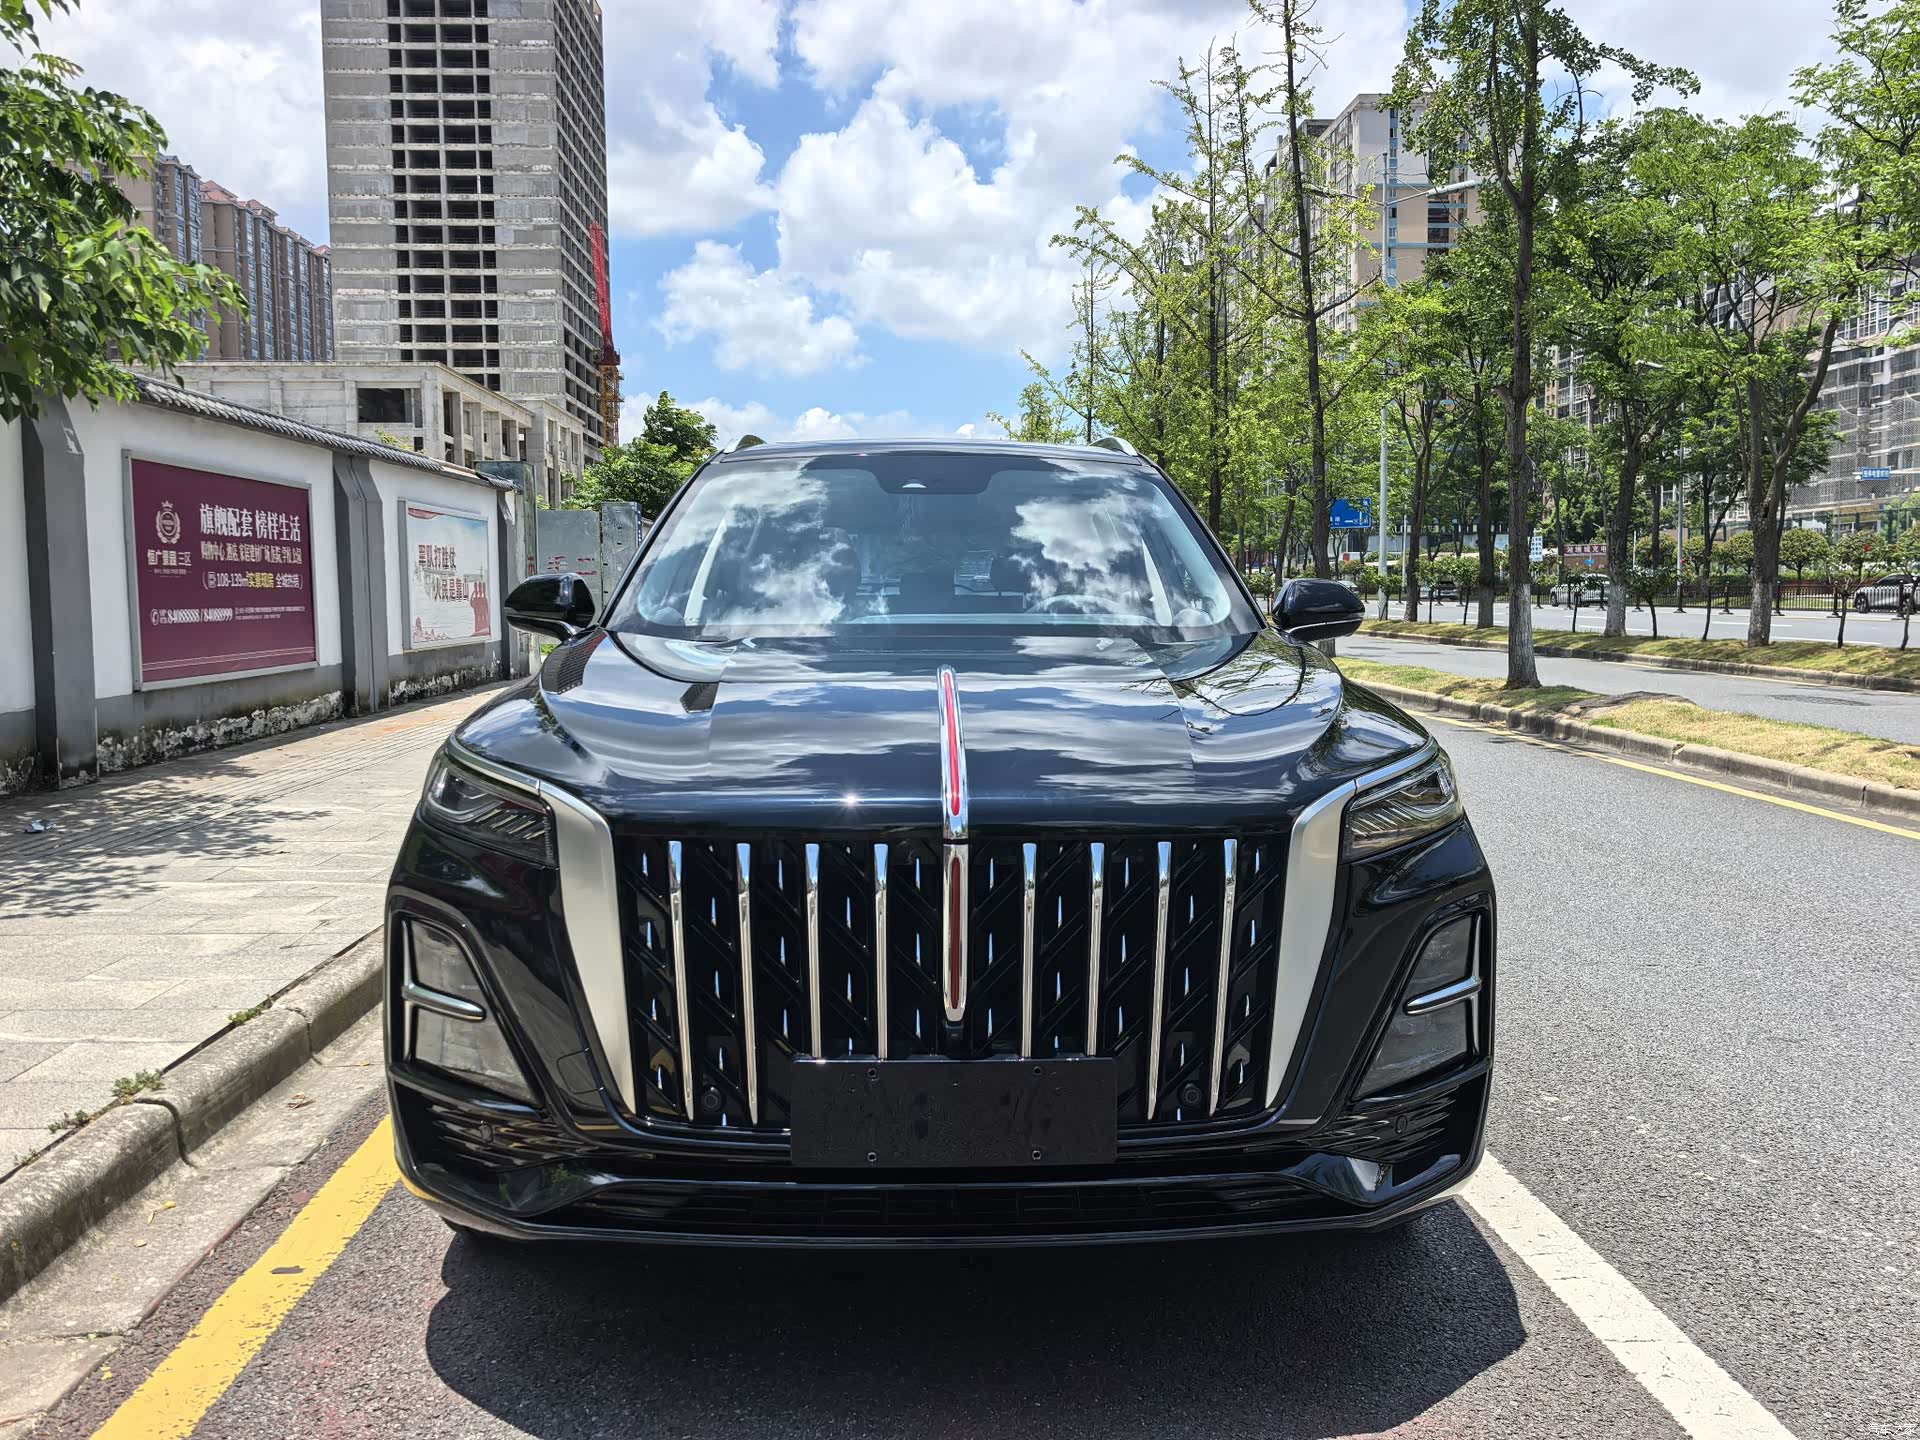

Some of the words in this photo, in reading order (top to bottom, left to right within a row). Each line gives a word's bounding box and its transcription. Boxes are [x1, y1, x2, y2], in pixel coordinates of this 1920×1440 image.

[200, 503, 253, 538] 旗舰配套
[255, 509, 301, 542] 榜样生活
[418, 544, 457, 572] 军队打胜仗
[433, 577, 470, 602] 人民是靠山
